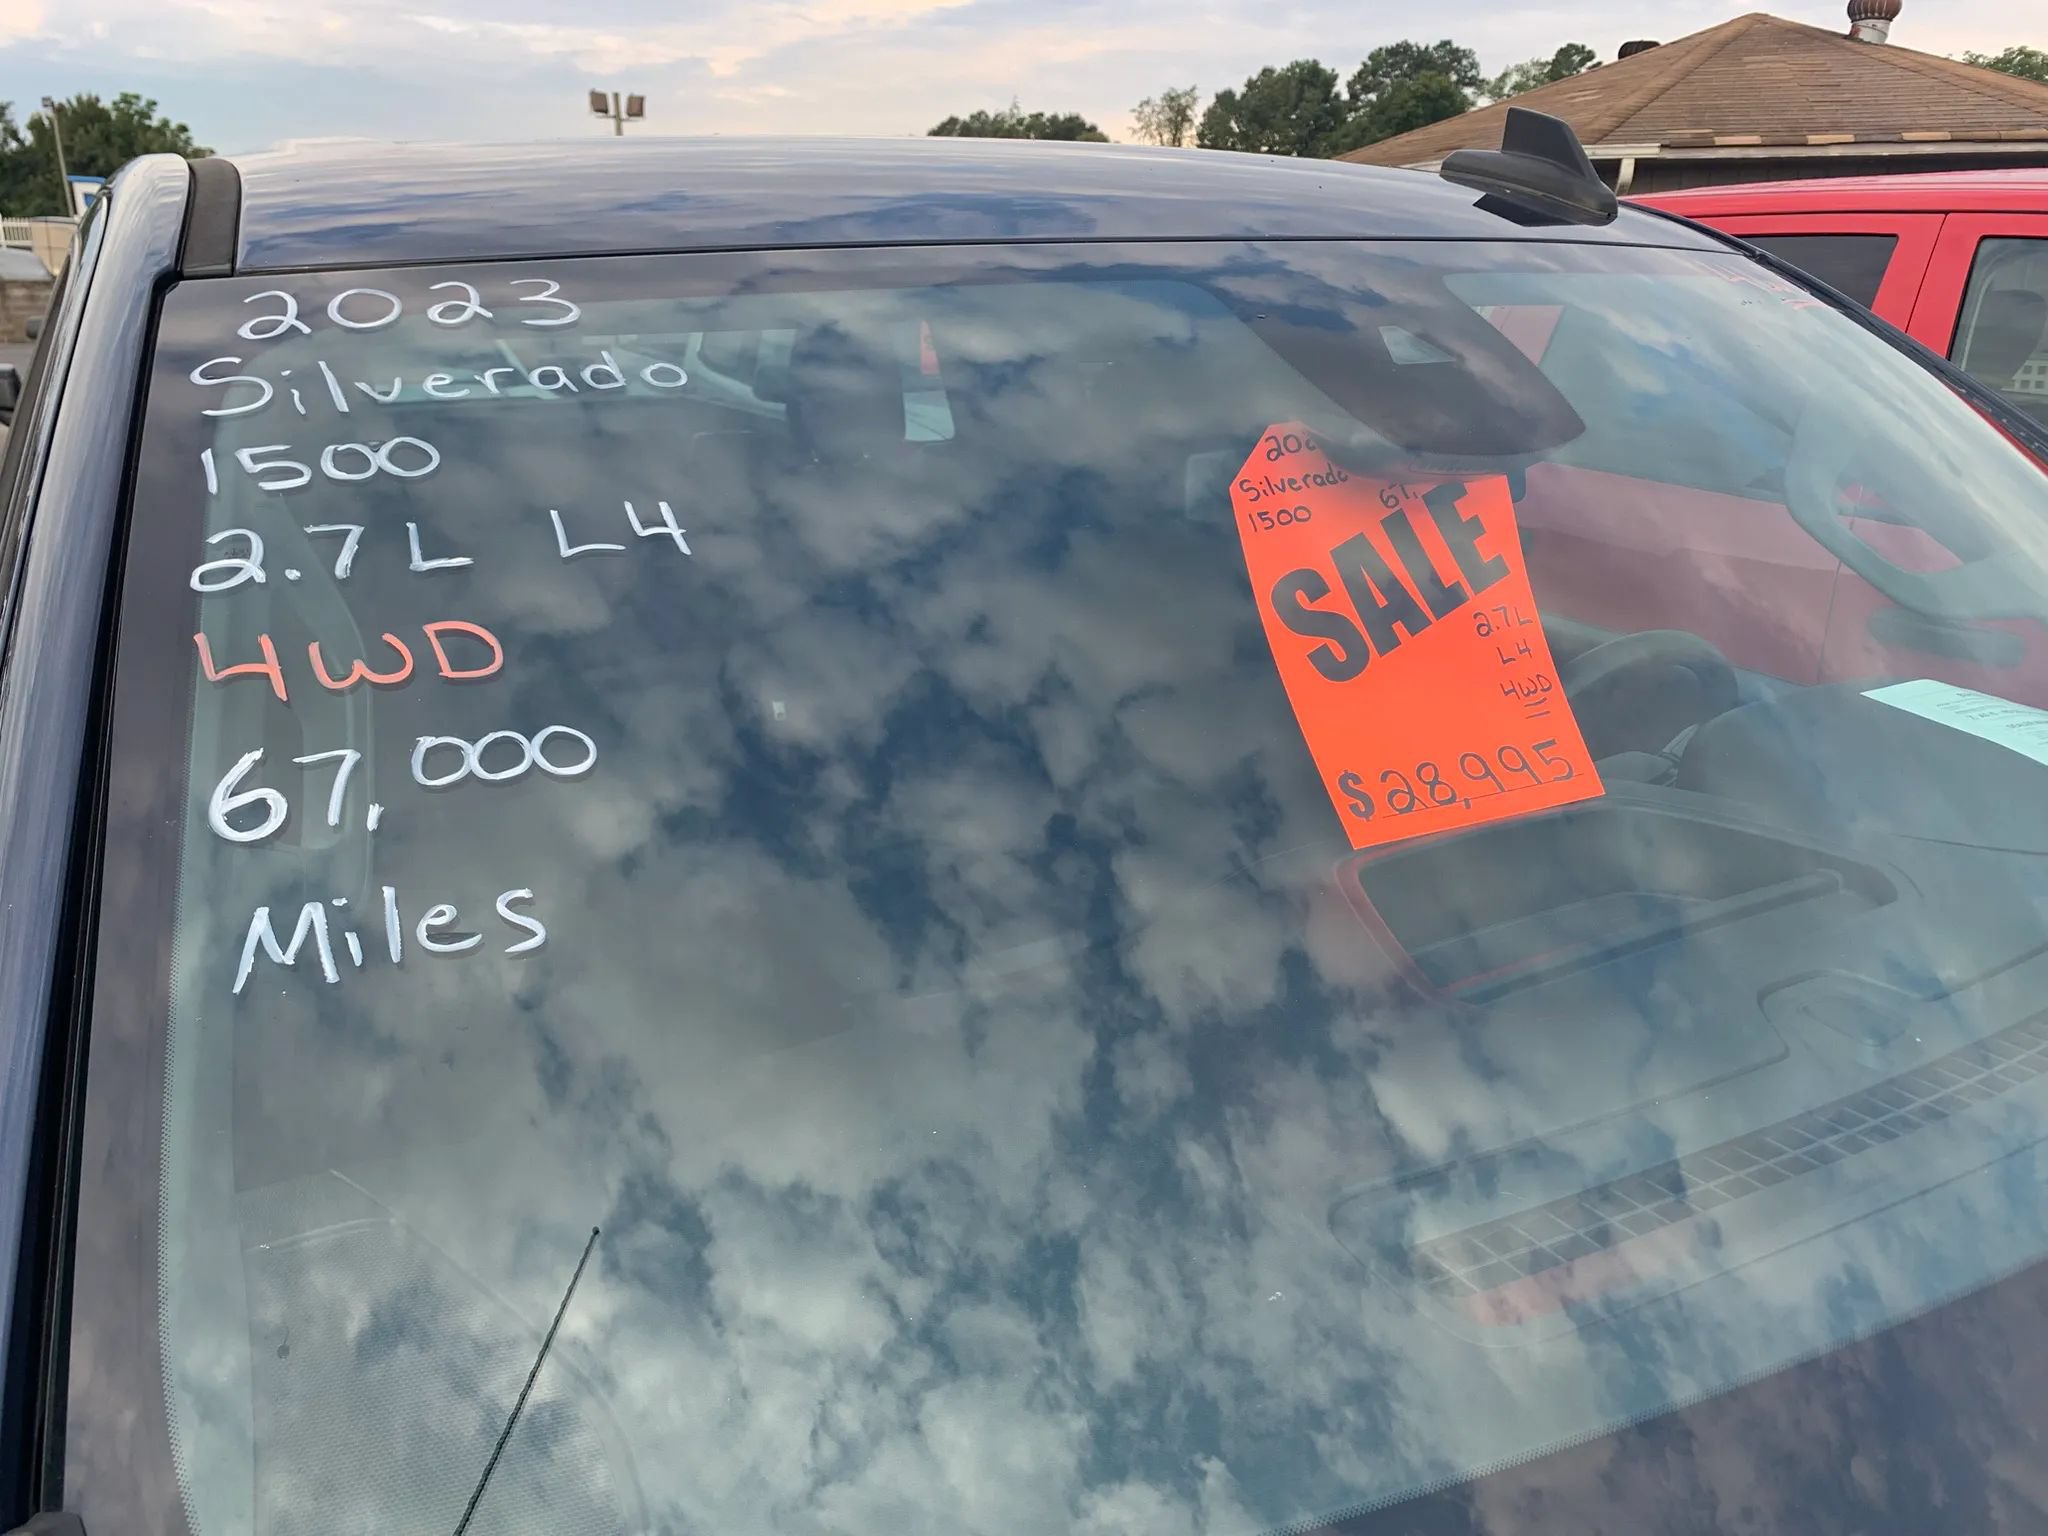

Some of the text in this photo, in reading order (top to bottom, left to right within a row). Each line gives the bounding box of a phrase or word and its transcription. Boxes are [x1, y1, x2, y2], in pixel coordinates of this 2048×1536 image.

[236, 278, 582, 340] 2023
[189, 350, 689, 416] Silverado
[201, 436, 441, 495] 1500
[189, 500, 693, 592] 2.7L L4
[1247, 505, 1312, 533] 1500
[1270, 481, 1512, 683] SALE
[1472, 605, 1534, 638] 2.7L
[1495, 638, 1533, 665] L4
[192, 619, 504, 702] 4WD
[1499, 673, 1553, 701] 4WD
[231, 885, 548, 995] Miles
